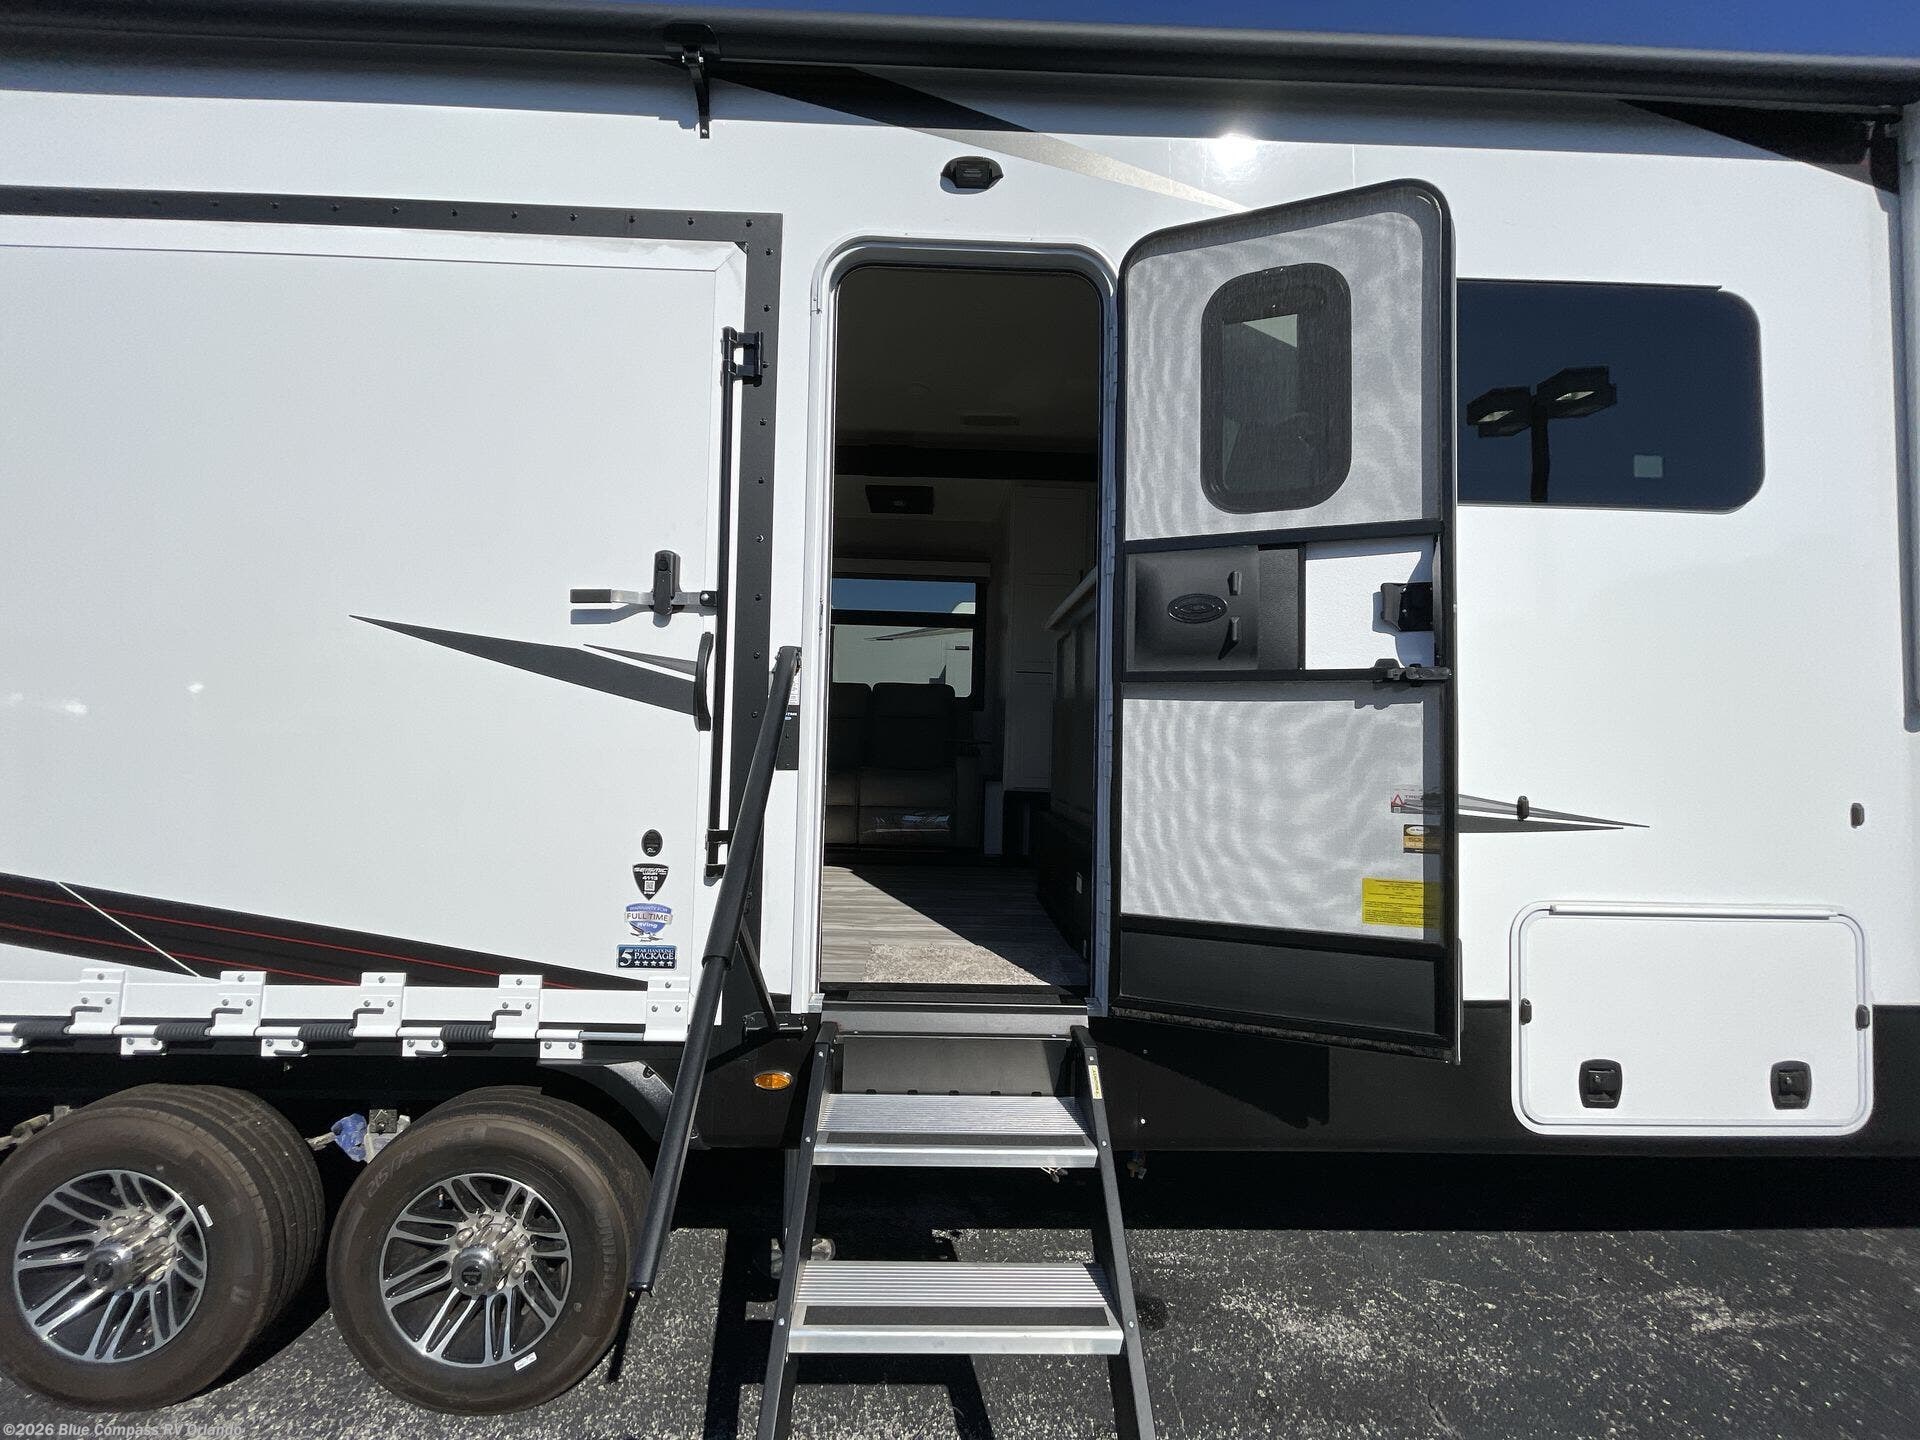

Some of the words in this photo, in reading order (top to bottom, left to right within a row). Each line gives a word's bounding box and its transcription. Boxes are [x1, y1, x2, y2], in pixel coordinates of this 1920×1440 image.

[649, 913, 669, 921] TIME
[619, 949, 633, 967] 5
[634, 952, 675, 960] PACKAGE
